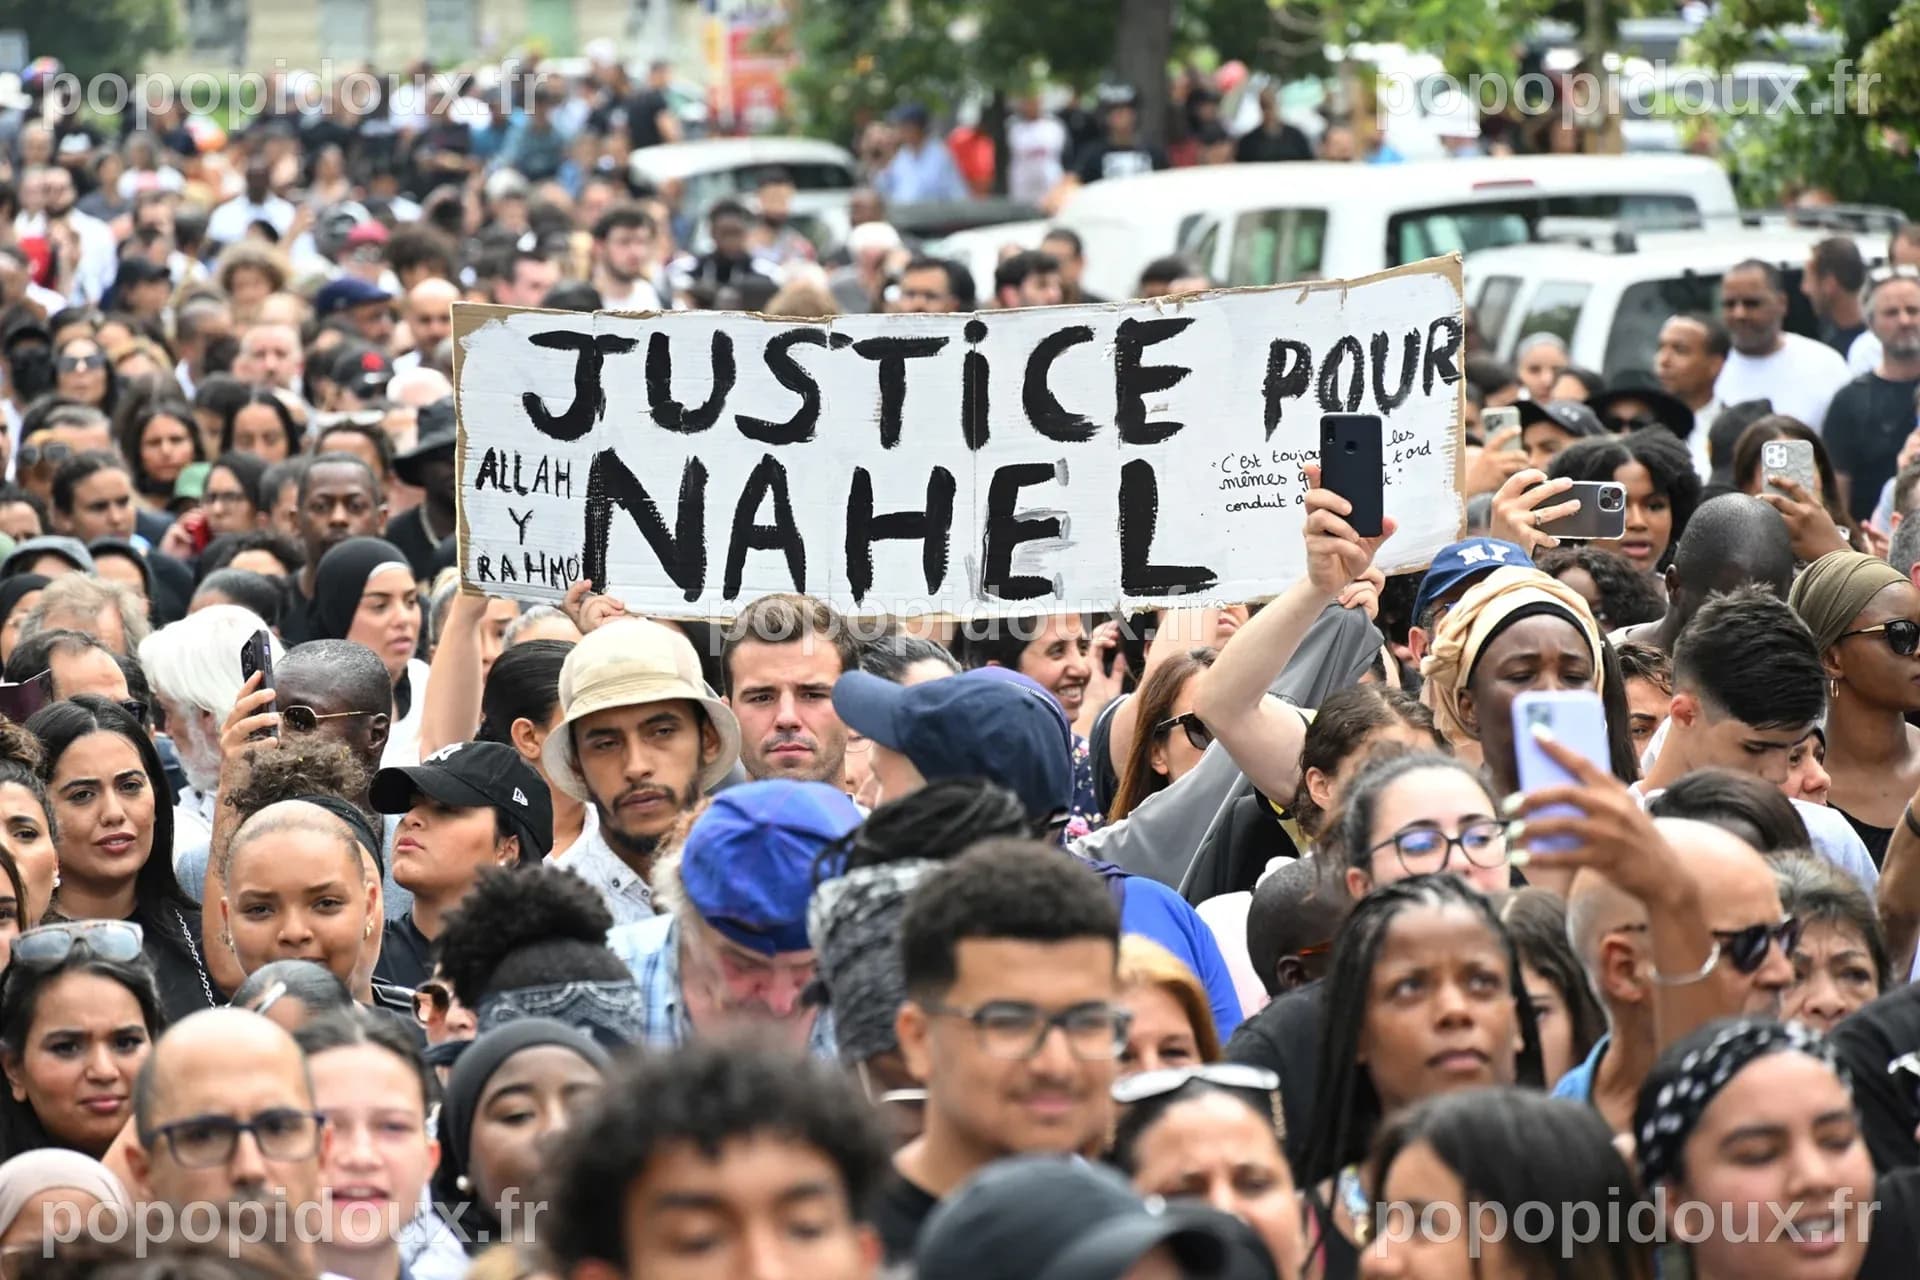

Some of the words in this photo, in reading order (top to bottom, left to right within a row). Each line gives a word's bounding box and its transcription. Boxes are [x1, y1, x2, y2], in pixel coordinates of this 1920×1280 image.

[1262, 316, 1464, 442] POUR
[1272, 449, 1321, 470] toujou
[1386, 429, 1416, 446] les
[475, 447, 571, 499] ALLAH
[1219, 471, 1288, 490] mêmes
[1226, 492, 1288, 512] conduit
[508, 507, 534, 546] Y
[582, 447, 1219, 607] NAHEL
[477, 552, 580, 591] RAHMO
[1457, 543, 1511, 566] NY
